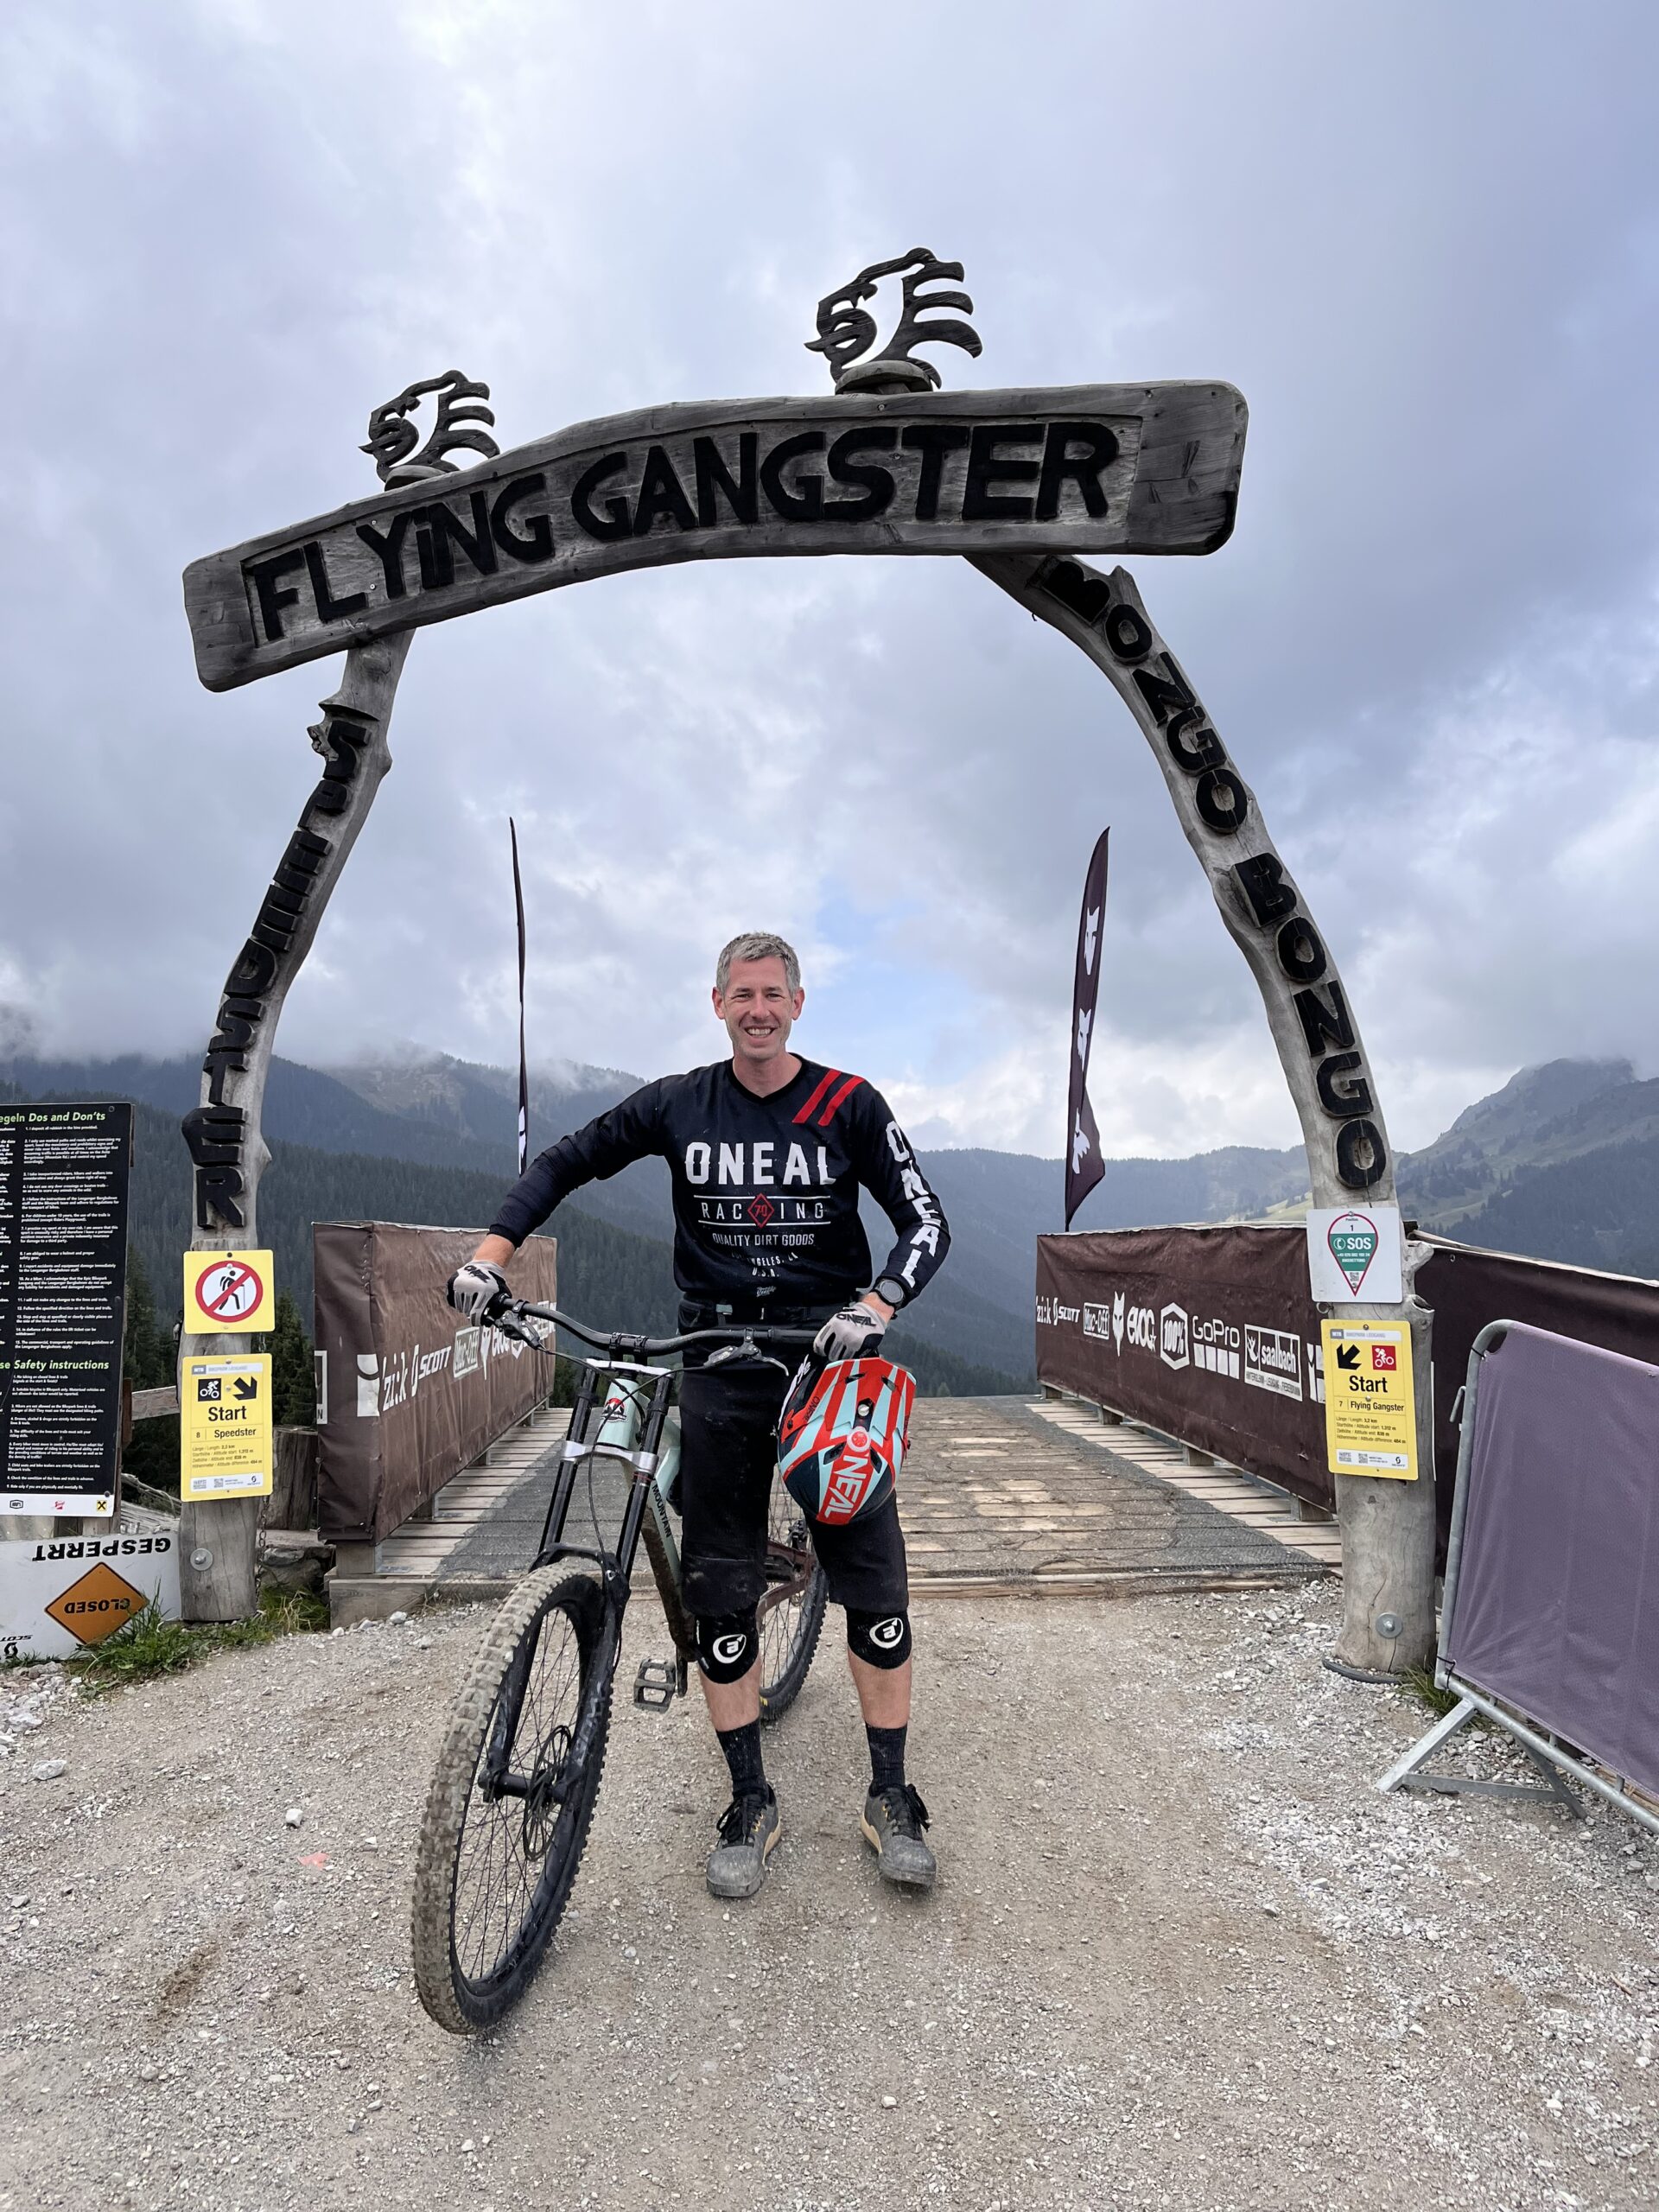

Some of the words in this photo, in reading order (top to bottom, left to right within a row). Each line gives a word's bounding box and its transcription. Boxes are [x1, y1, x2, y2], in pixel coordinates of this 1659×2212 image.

[570, 419, 1121, 543] GANGSTER
[1044, 560, 1249, 834] BONGO
[1230, 852, 1387, 1189] BONGO
[181, 719, 371, 1230] SPEEDSTER
[29, 1113, 48, 1122] Dos
[51, 1112, 70, 1122] and
[684, 1141, 836, 1185] ONEAL
[712, 1233, 750, 1247] QUALITY
[754, 1235, 778, 1246] DIRT
[782, 1234, 814, 1246] GOODS
[1347, 1237, 1372, 1250] SOS
[1058, 1306, 1081, 1323] SCOTT
[1164, 1319, 1185, 1355] 100%
[1192, 1315, 1240, 1348] GoPro
[1262, 1344, 1296, 1374] saalbach
[14, 1359, 47, 1372] Safety
[49, 1360, 110, 1370] instructions
[418, 1345, 451, 1380] SCOTT
[1349, 1375, 1389, 1393] Start
[208, 1405, 247, 1421] Start
[1351, 1401, 1371, 1411] Flying
[1373, 1402, 1404, 1412] Gangster
[214, 1428, 257, 1439] Speedster
[652, 1484, 672, 1538] MOUNTAIN
[31, 1537, 172, 1562] GESPERRT
[64, 1598, 131, 1614] CLOSED
